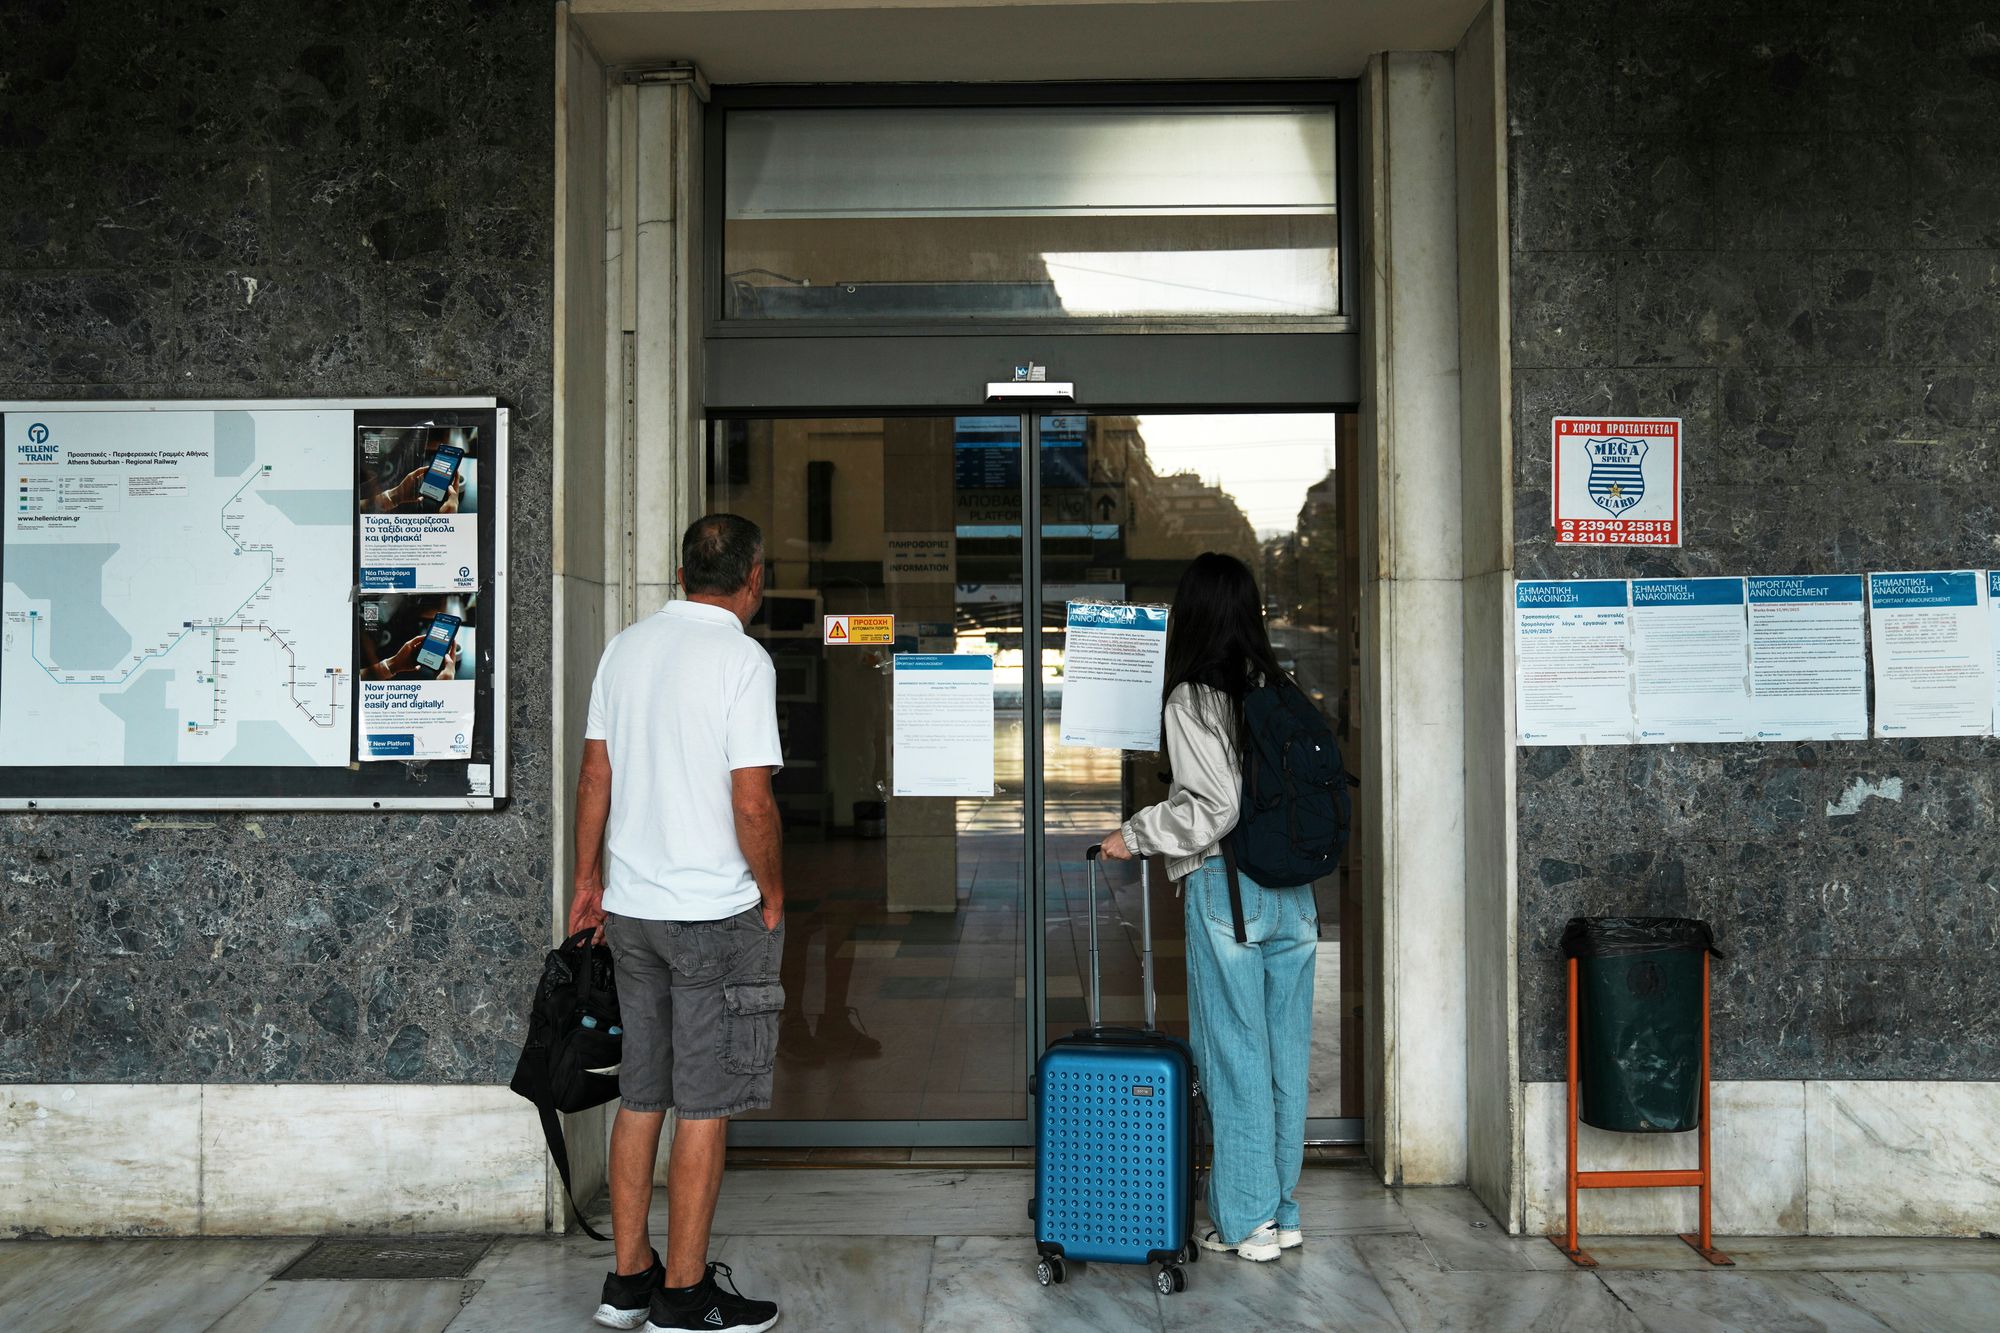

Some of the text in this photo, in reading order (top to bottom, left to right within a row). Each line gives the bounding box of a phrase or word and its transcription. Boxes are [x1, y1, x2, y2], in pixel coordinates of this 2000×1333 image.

[1561, 424, 1674, 434] Ο ΧΩΡΟΣ ΠΡΟΣΤΑΤΕΥΕΤΑΙ
[1594, 442, 1640, 456] MEGA
[1597, 496, 1635, 508] GUARD
[365, 516, 450, 526] Τώρα, διαχειρίζεσαι
[379, 526, 403, 534] ταξίδι
[1578, 521, 1672, 531] 23940 25818
[381, 534, 422, 543] ψηφιακά!
[1579, 532, 1670, 543] 210 5748041
[890, 564, 950, 572] INFORMATION
[1749, 580, 1804, 589] IMPORTANT
[1873, 578, 1926, 587] ΣΗΜΑΝΤΙΚΗ
[1519, 586, 1571, 595] ΣΗΜΑΝΤΙΚΗ
[1635, 585, 1687, 593] ΣΗΜΑΝΤΙΚΗ
[1750, 588, 1829, 597] ANNOUNCEMENT
[1873, 586, 1933, 595] ΑΝΑΚΟΙΝΩΣΗ
[1519, 594, 1578, 603] ΑΝΑΚΟΙΝΩΣΗ
[1635, 592, 1695, 601] ΑΝΑΚΟΙΝΩΣΗ
[1070, 614, 1136, 625] ANNOUNCEMENT
[386, 692, 418, 700] journey
[364, 701, 389, 709] easily
[410, 700, 444, 709] digitally!
